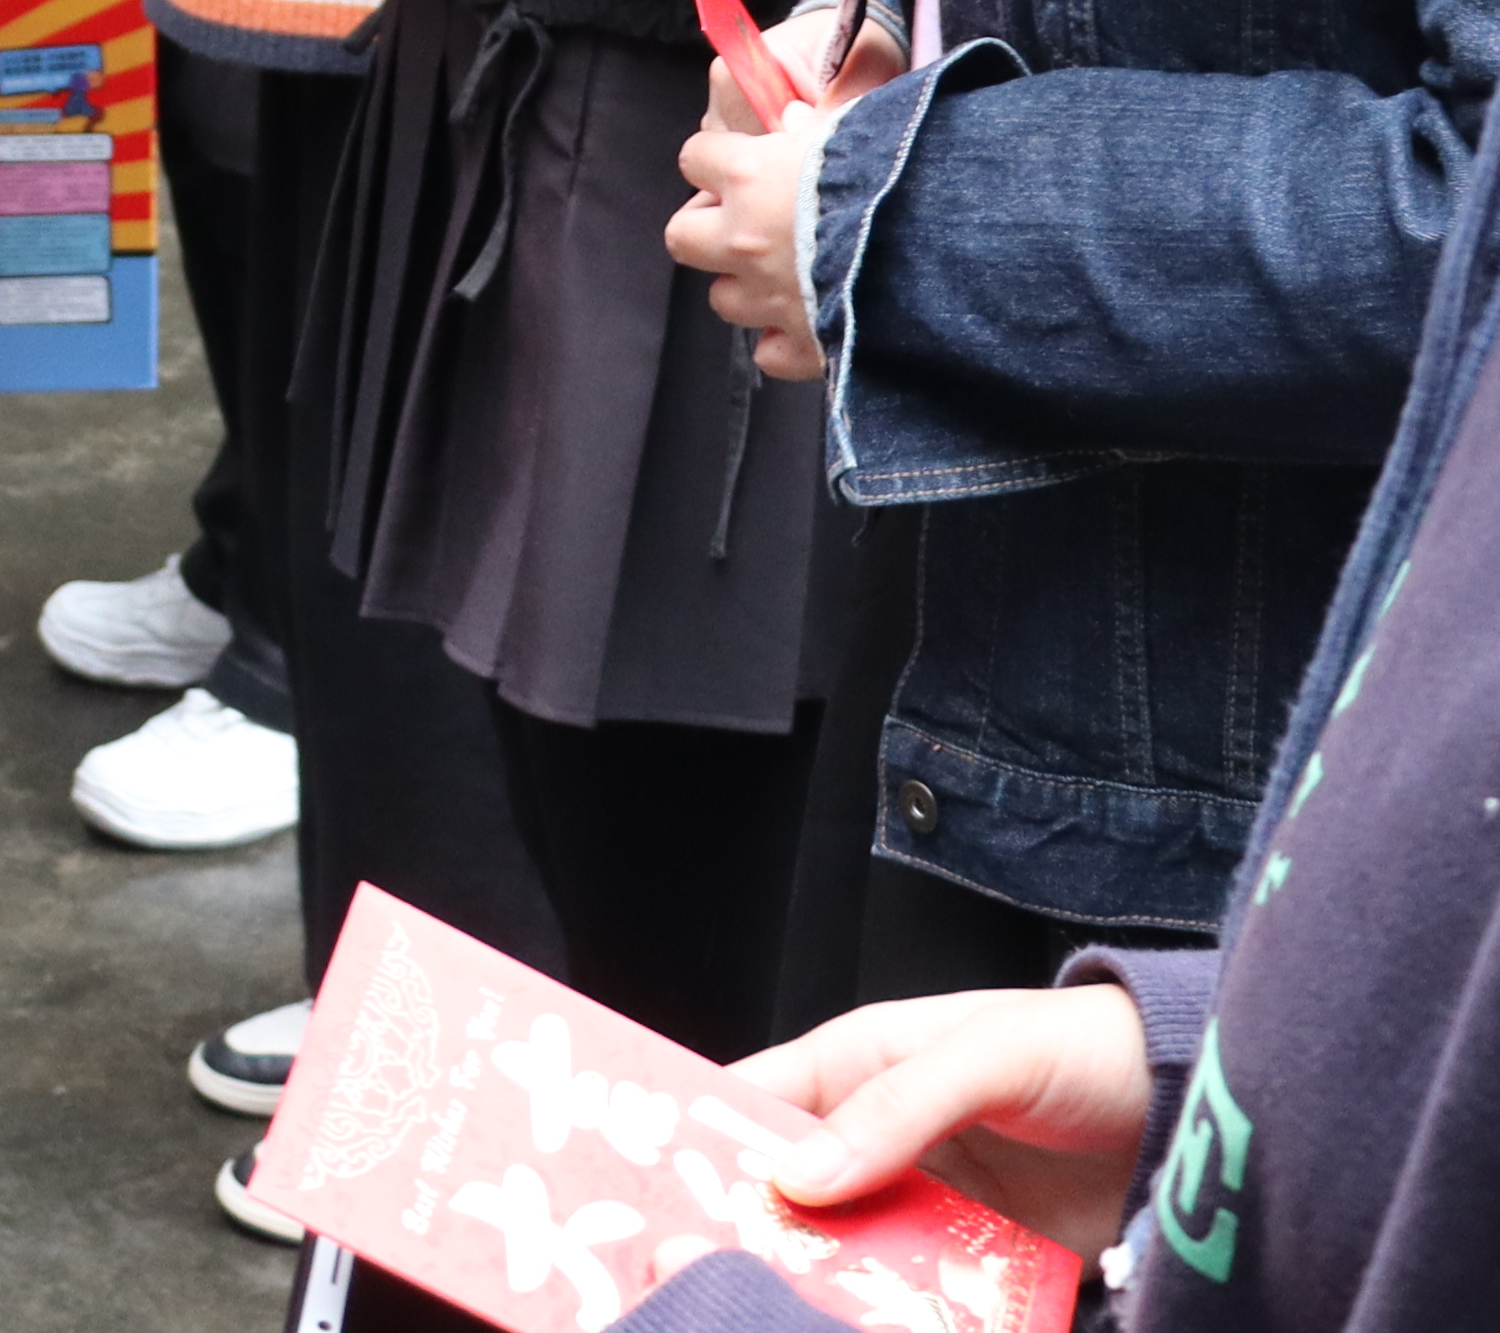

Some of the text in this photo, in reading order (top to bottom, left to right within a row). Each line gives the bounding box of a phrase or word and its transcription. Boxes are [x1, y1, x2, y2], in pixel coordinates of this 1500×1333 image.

[400, 986, 506, 1236] Best Wishes For You!
